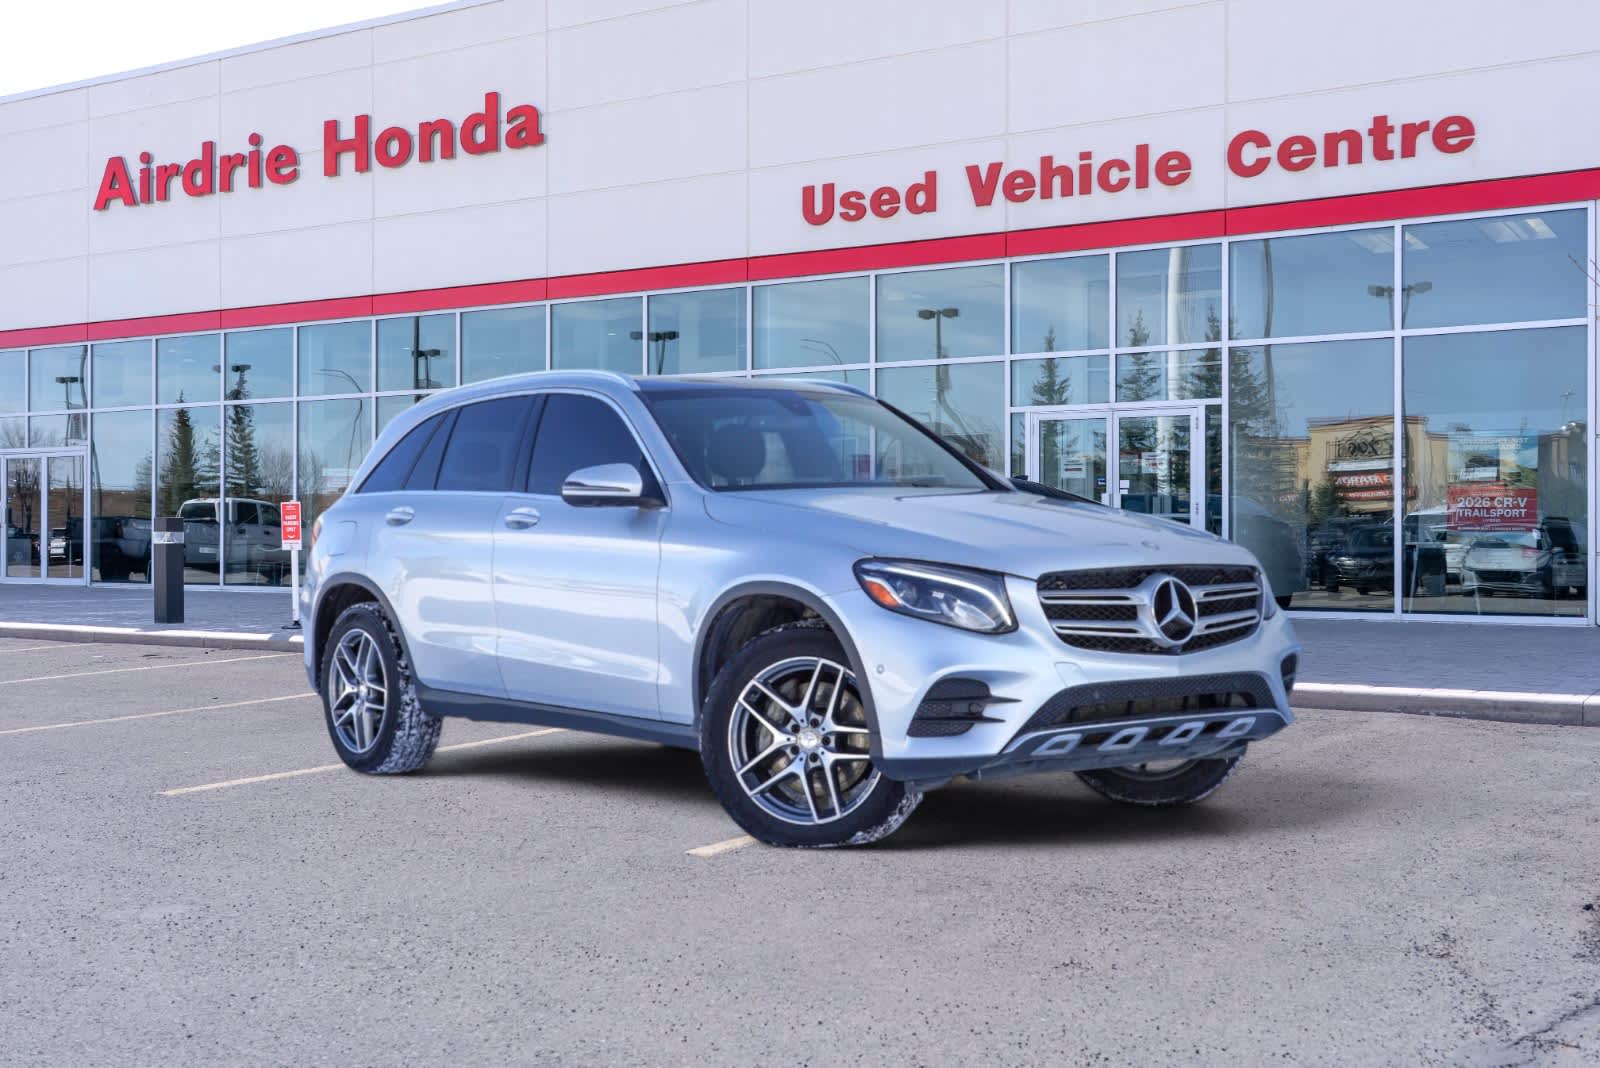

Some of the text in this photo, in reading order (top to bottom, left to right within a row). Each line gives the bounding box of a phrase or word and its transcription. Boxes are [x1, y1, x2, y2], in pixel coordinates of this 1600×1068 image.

[94, 92, 547, 211] Airdrie Honda
[801, 115, 1476, 226] Used Vehicle Centre
[1457, 497, 1528, 508] 2026 CR-V
[1459, 508, 1528, 518] TRAILSPORT
